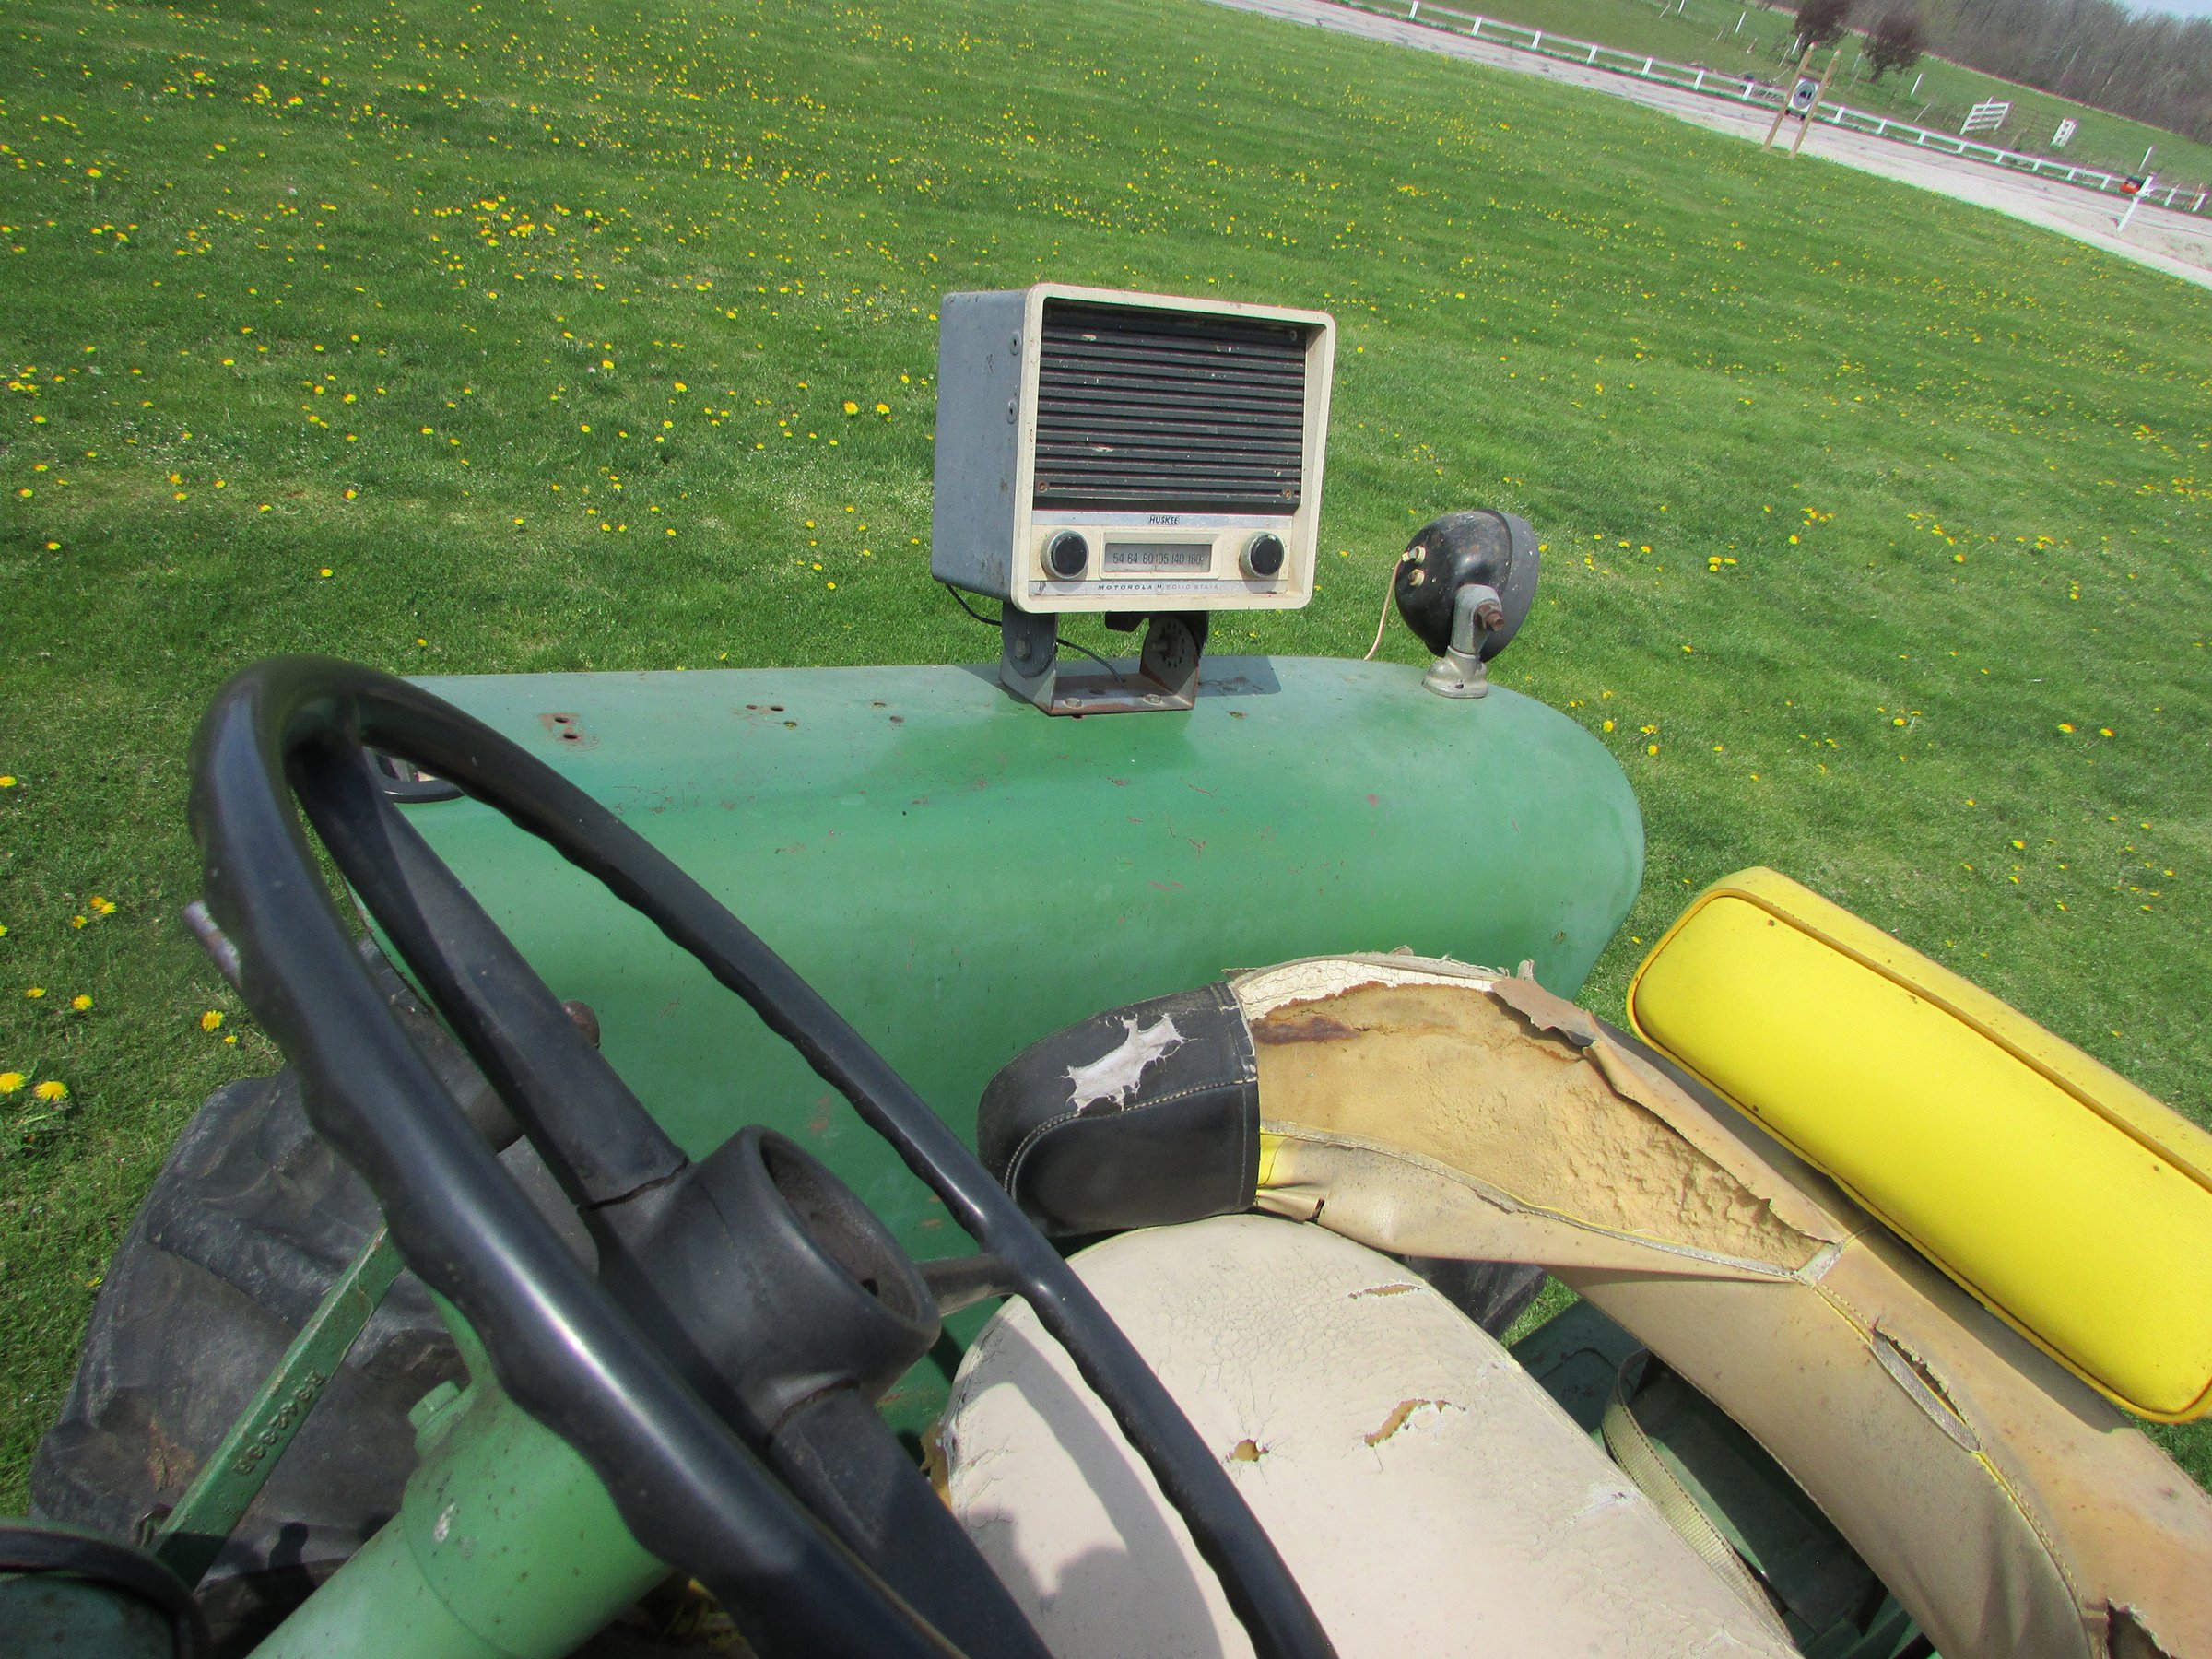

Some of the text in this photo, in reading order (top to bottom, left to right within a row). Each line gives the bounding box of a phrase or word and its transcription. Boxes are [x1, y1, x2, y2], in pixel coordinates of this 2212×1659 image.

[1149, 516, 1178, 524] HUSKEE
[1113, 553, 1124, 564] 54
[1127, 553, 1138, 564] 64
[1143, 553, 1154, 564] 80
[1171, 553, 1184, 564] 140
